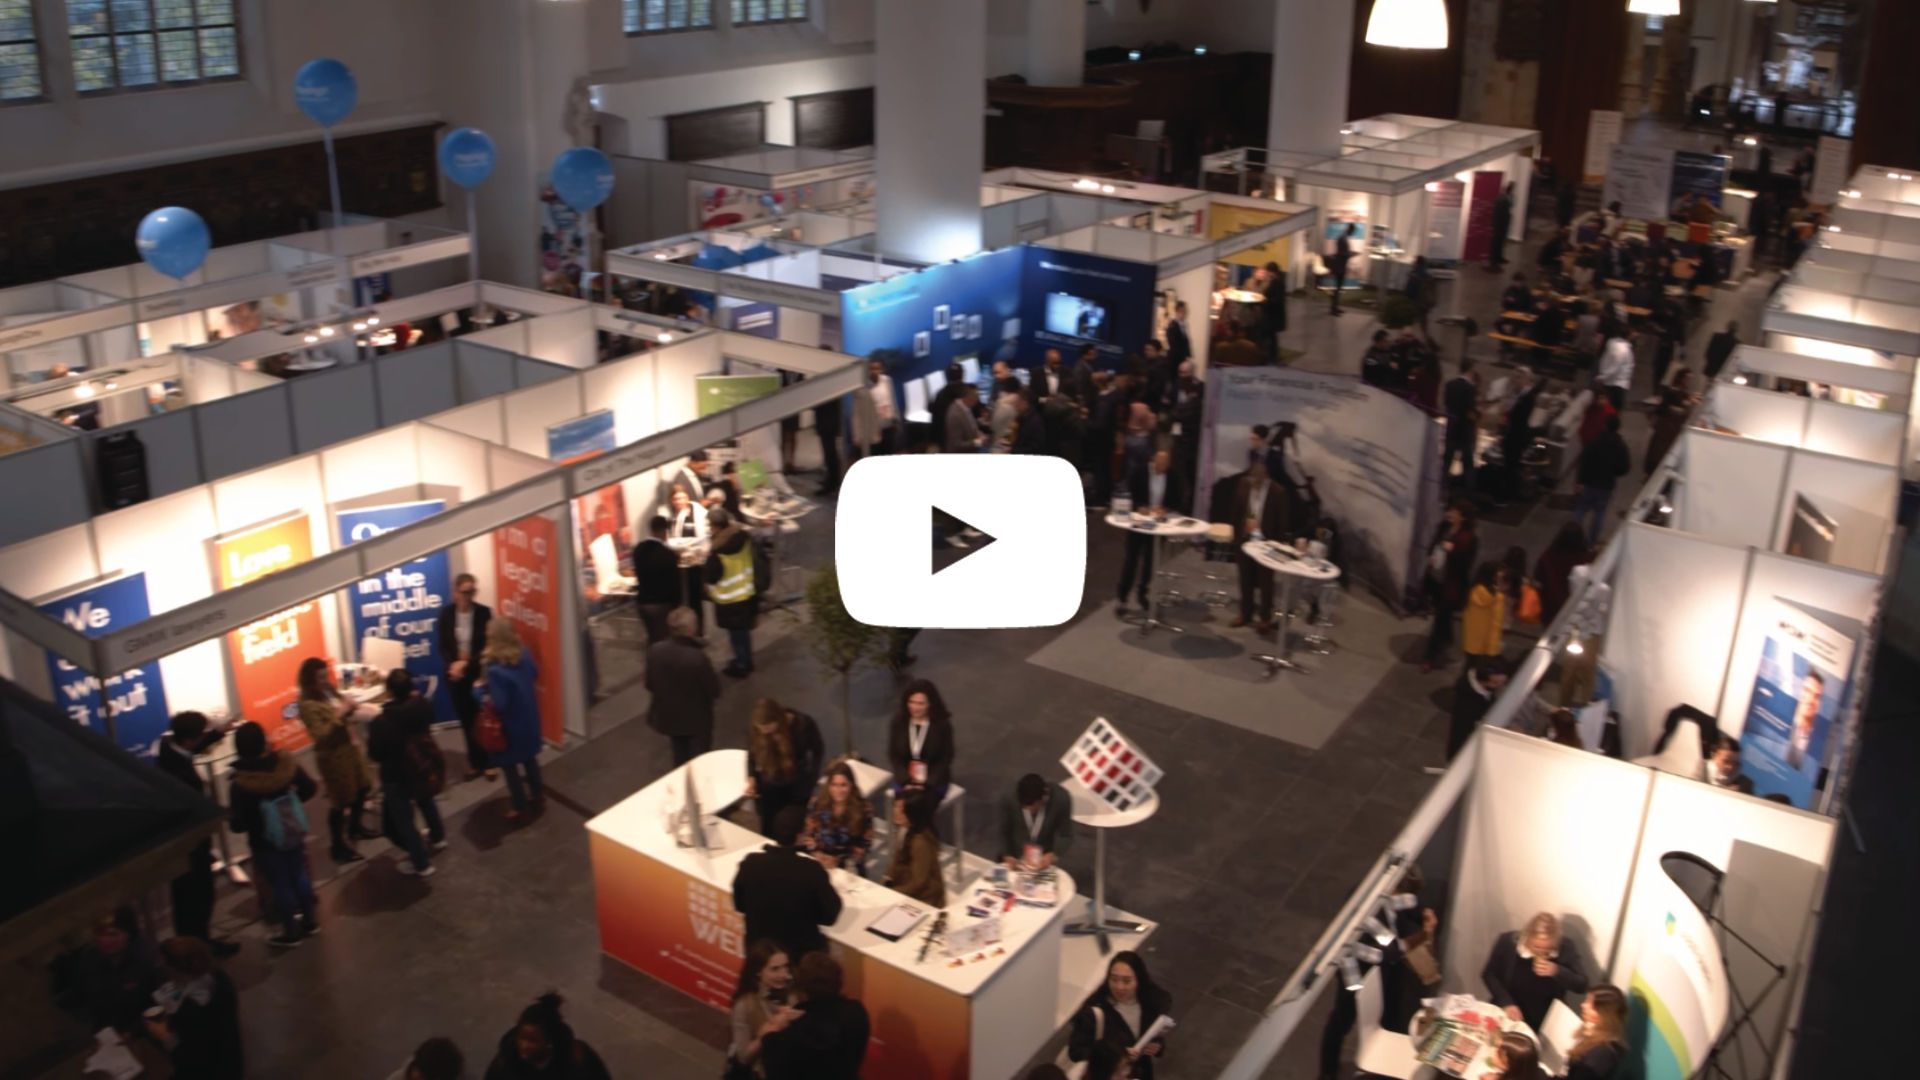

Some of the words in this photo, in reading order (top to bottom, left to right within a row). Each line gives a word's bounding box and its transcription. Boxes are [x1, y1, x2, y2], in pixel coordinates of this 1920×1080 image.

[229, 544, 291, 579] Love
[500, 547, 548, 593] legal
[386, 568, 426, 590] the
[62, 601, 111, 631] We
[361, 587, 443, 618] middle
[501, 592, 549, 632] alien
[241, 618, 299, 664] field
[364, 616, 391, 639] of
[395, 617, 437, 636] our
